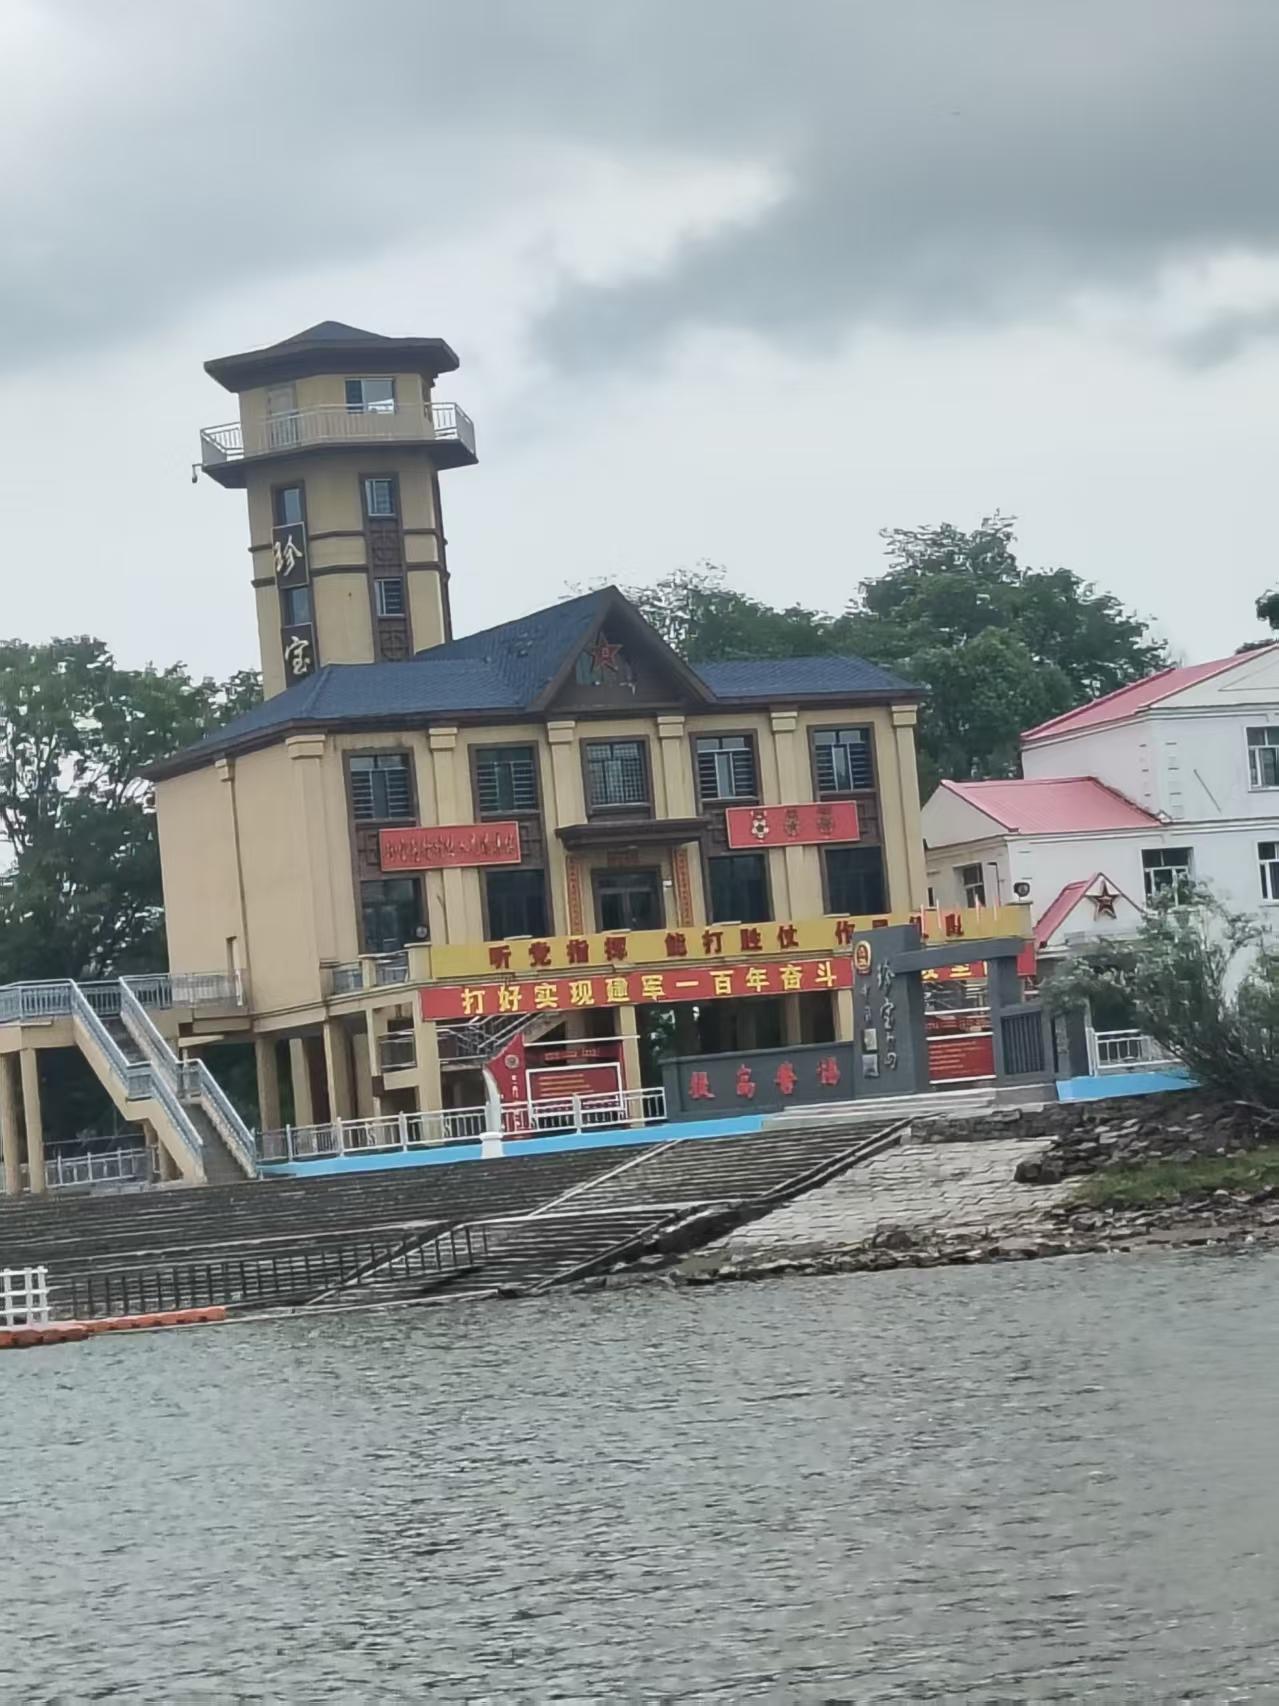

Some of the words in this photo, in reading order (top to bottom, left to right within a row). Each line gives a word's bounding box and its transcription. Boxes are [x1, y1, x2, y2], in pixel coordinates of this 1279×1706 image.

[461, 961, 837, 1014] 打好实现建军一百年奋斗
